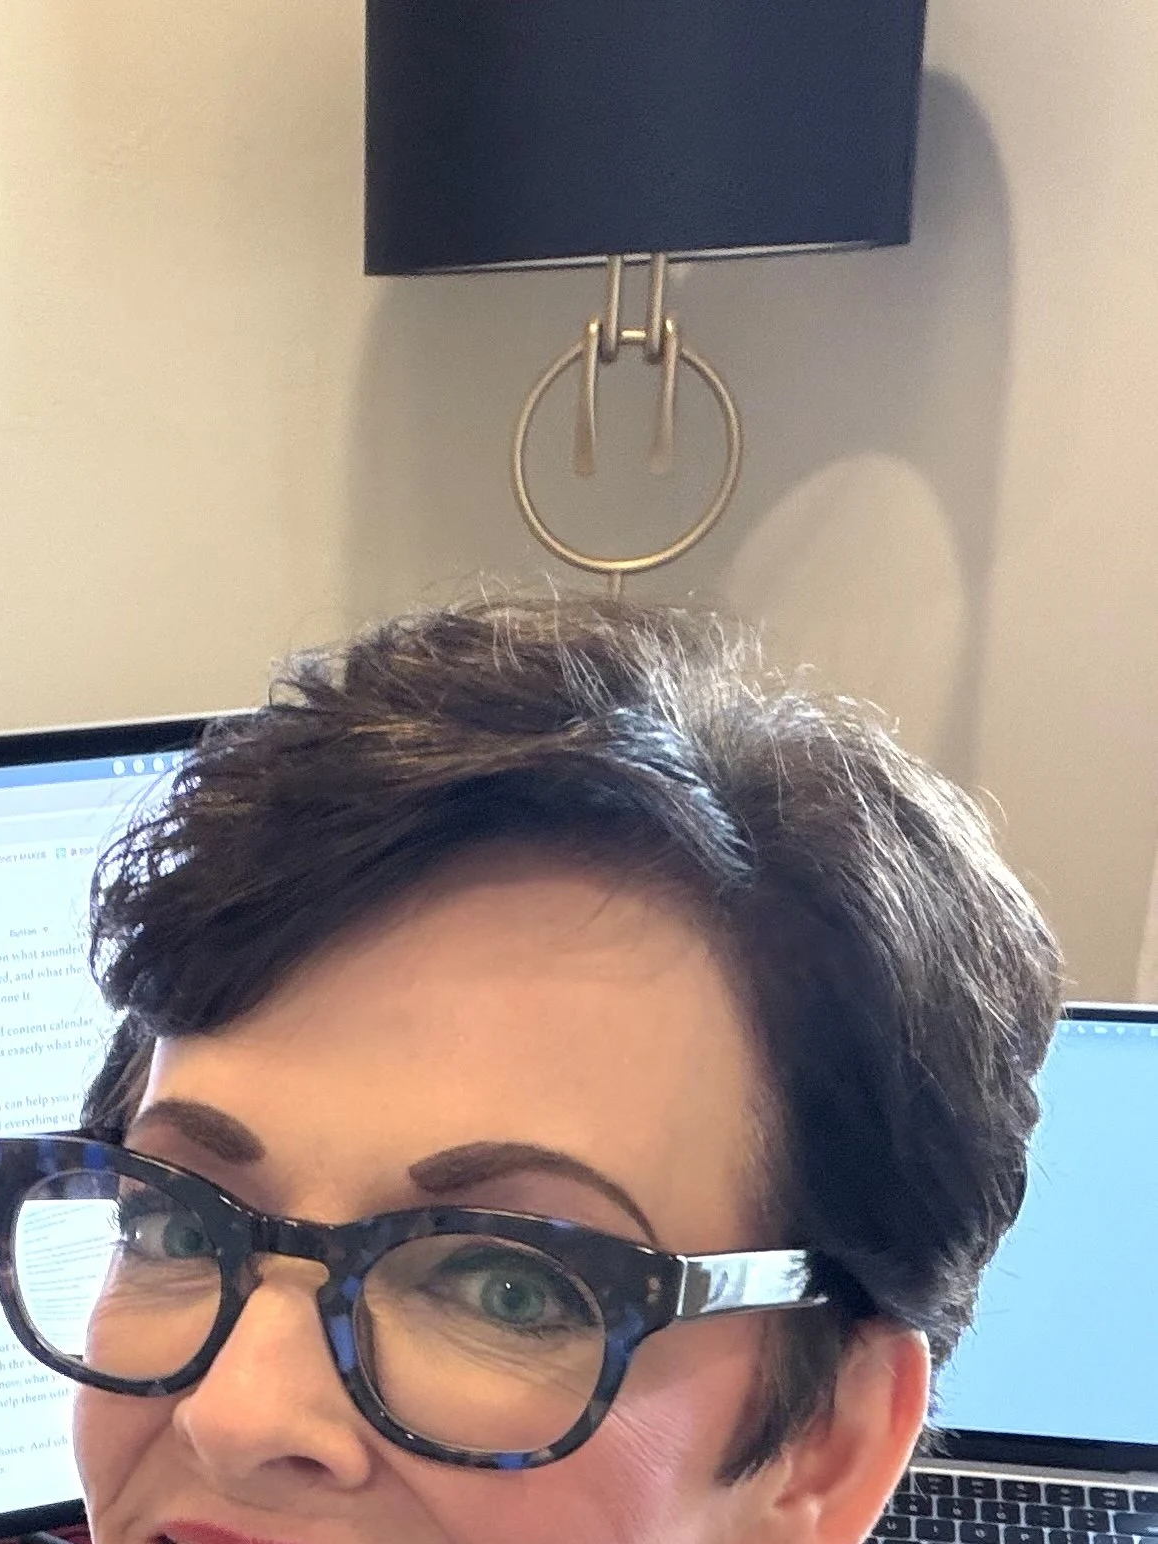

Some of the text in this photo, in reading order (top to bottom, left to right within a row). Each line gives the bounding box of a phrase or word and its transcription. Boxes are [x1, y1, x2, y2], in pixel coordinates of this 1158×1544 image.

[11, 949, 37, 961] what
[4, 1113, 58, 1129] everything
[8, 1359, 26, 1370] the
[21, 1393, 47, 1404] them
